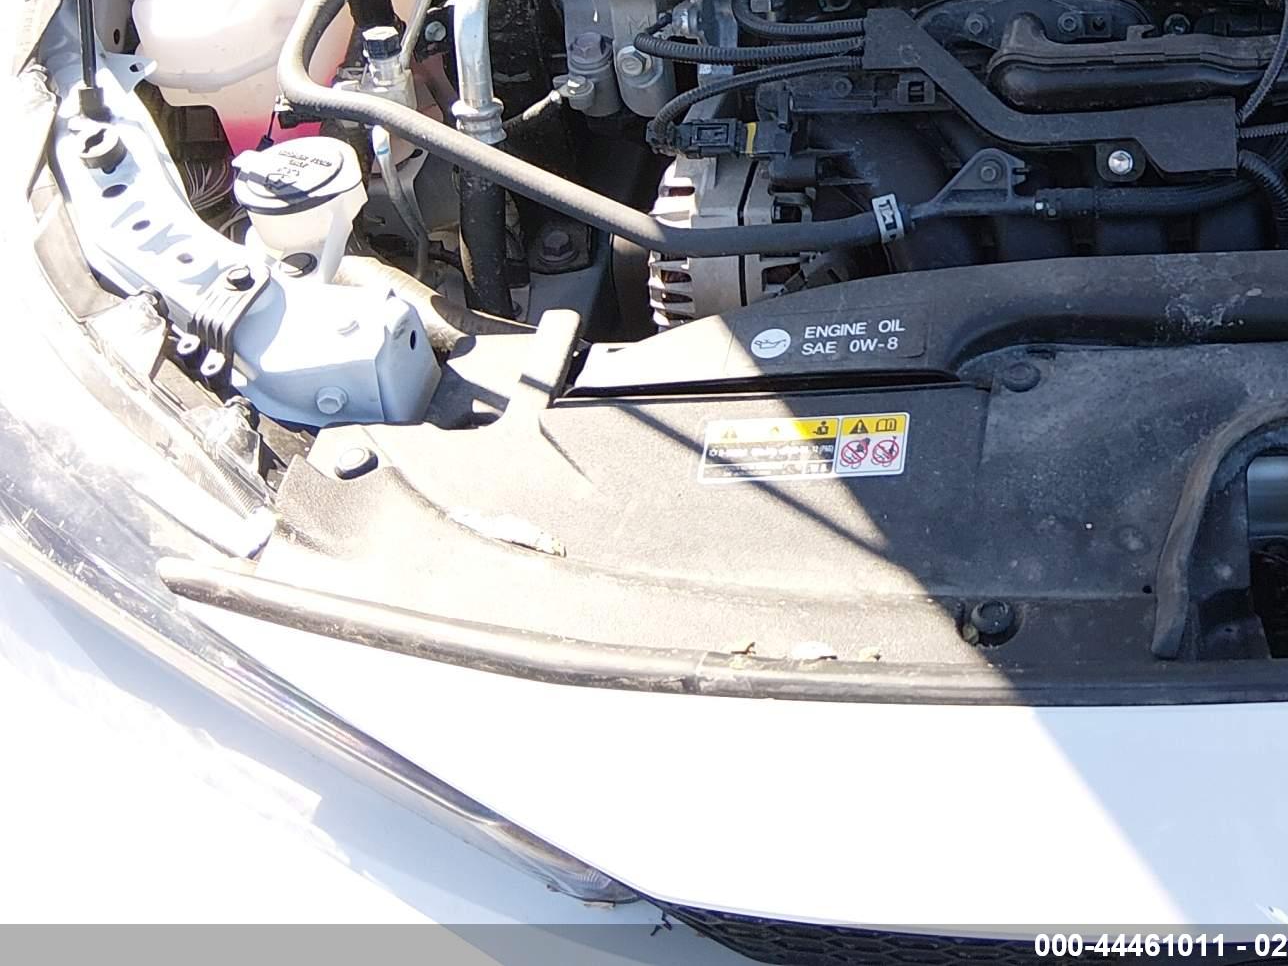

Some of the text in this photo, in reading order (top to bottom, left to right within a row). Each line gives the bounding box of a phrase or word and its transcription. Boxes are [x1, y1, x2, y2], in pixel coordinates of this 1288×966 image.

[804, 319, 906, 339] ENGINE OIL
[801, 336, 899, 356] SAE 0W-8
